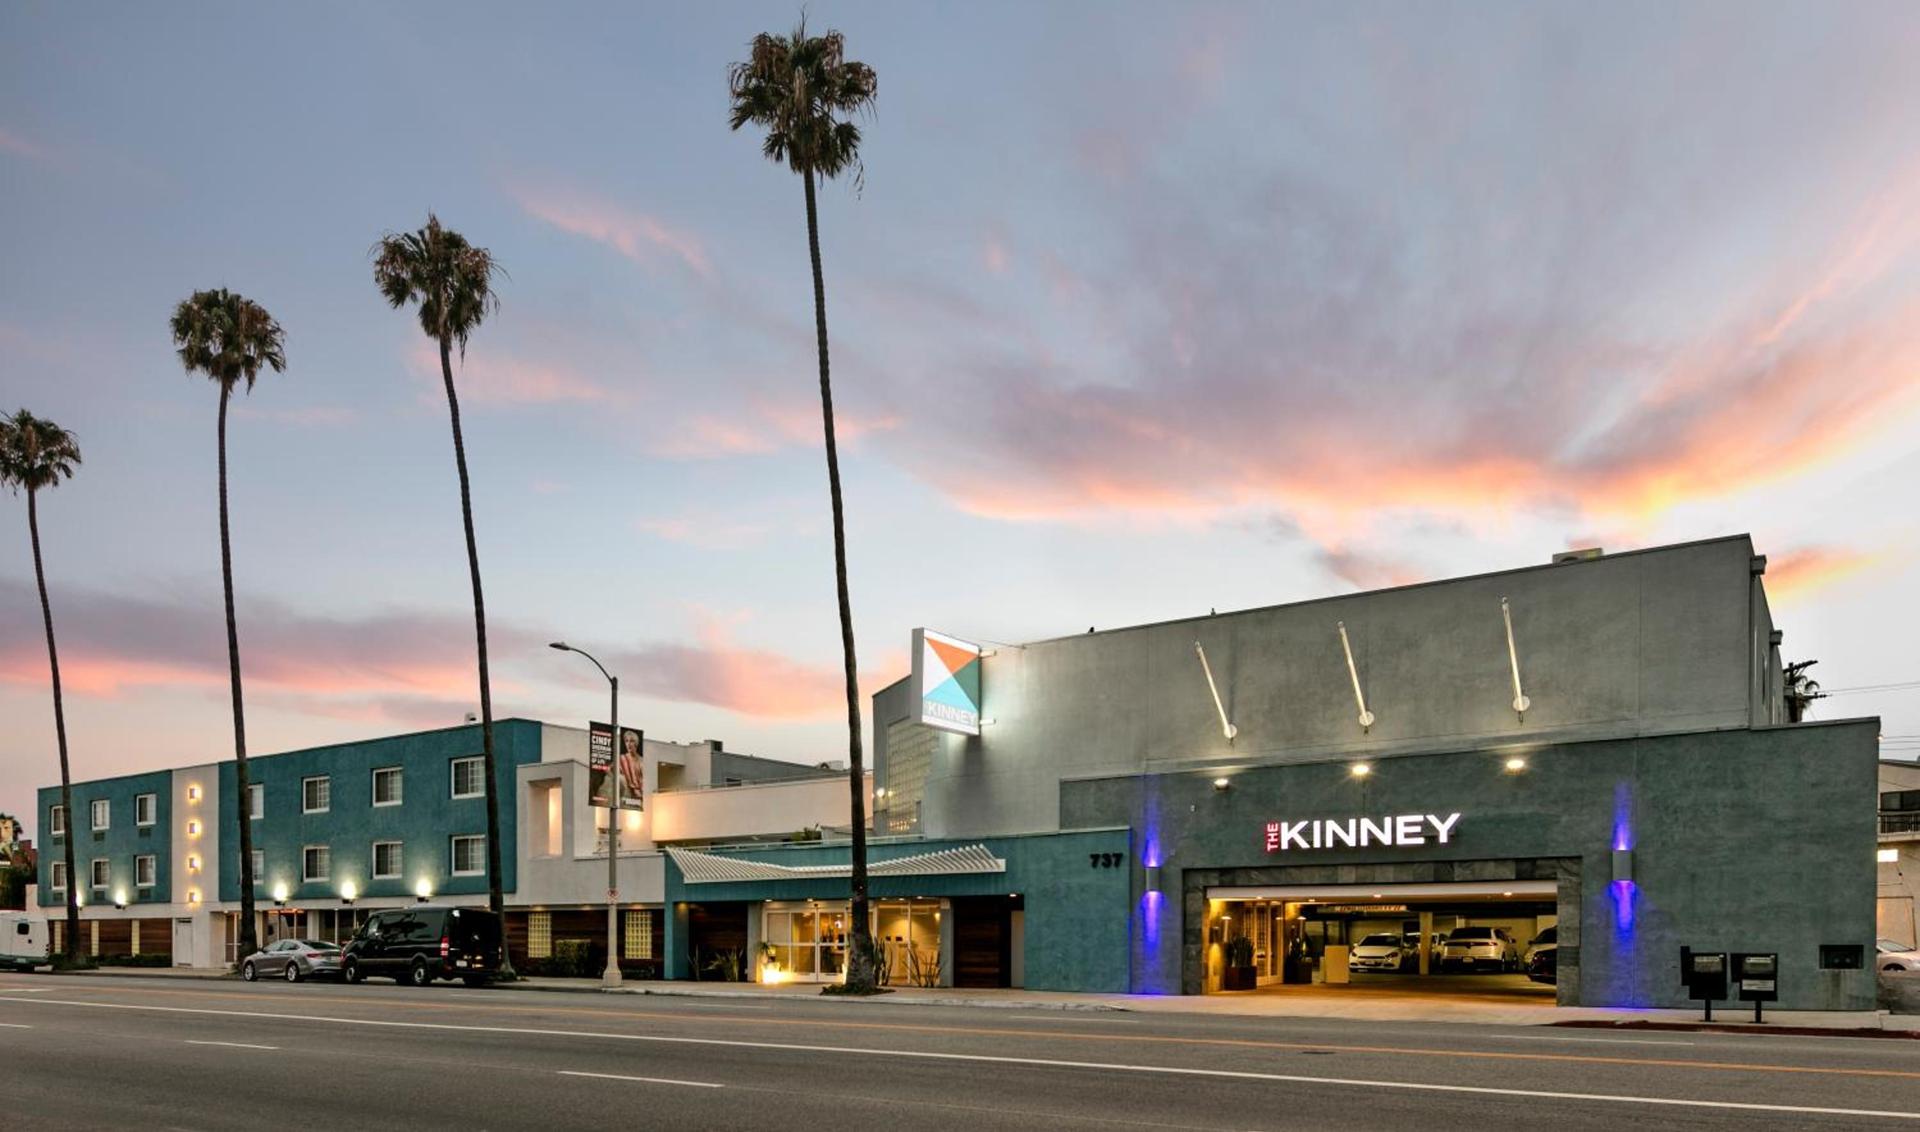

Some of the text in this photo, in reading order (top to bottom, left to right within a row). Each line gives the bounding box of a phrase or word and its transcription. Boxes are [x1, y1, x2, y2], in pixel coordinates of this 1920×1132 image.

[928, 701, 977, 726] KINNEY
[1267, 812, 1461, 852] THE KINNEY
[1090, 853, 1124, 869] 737
